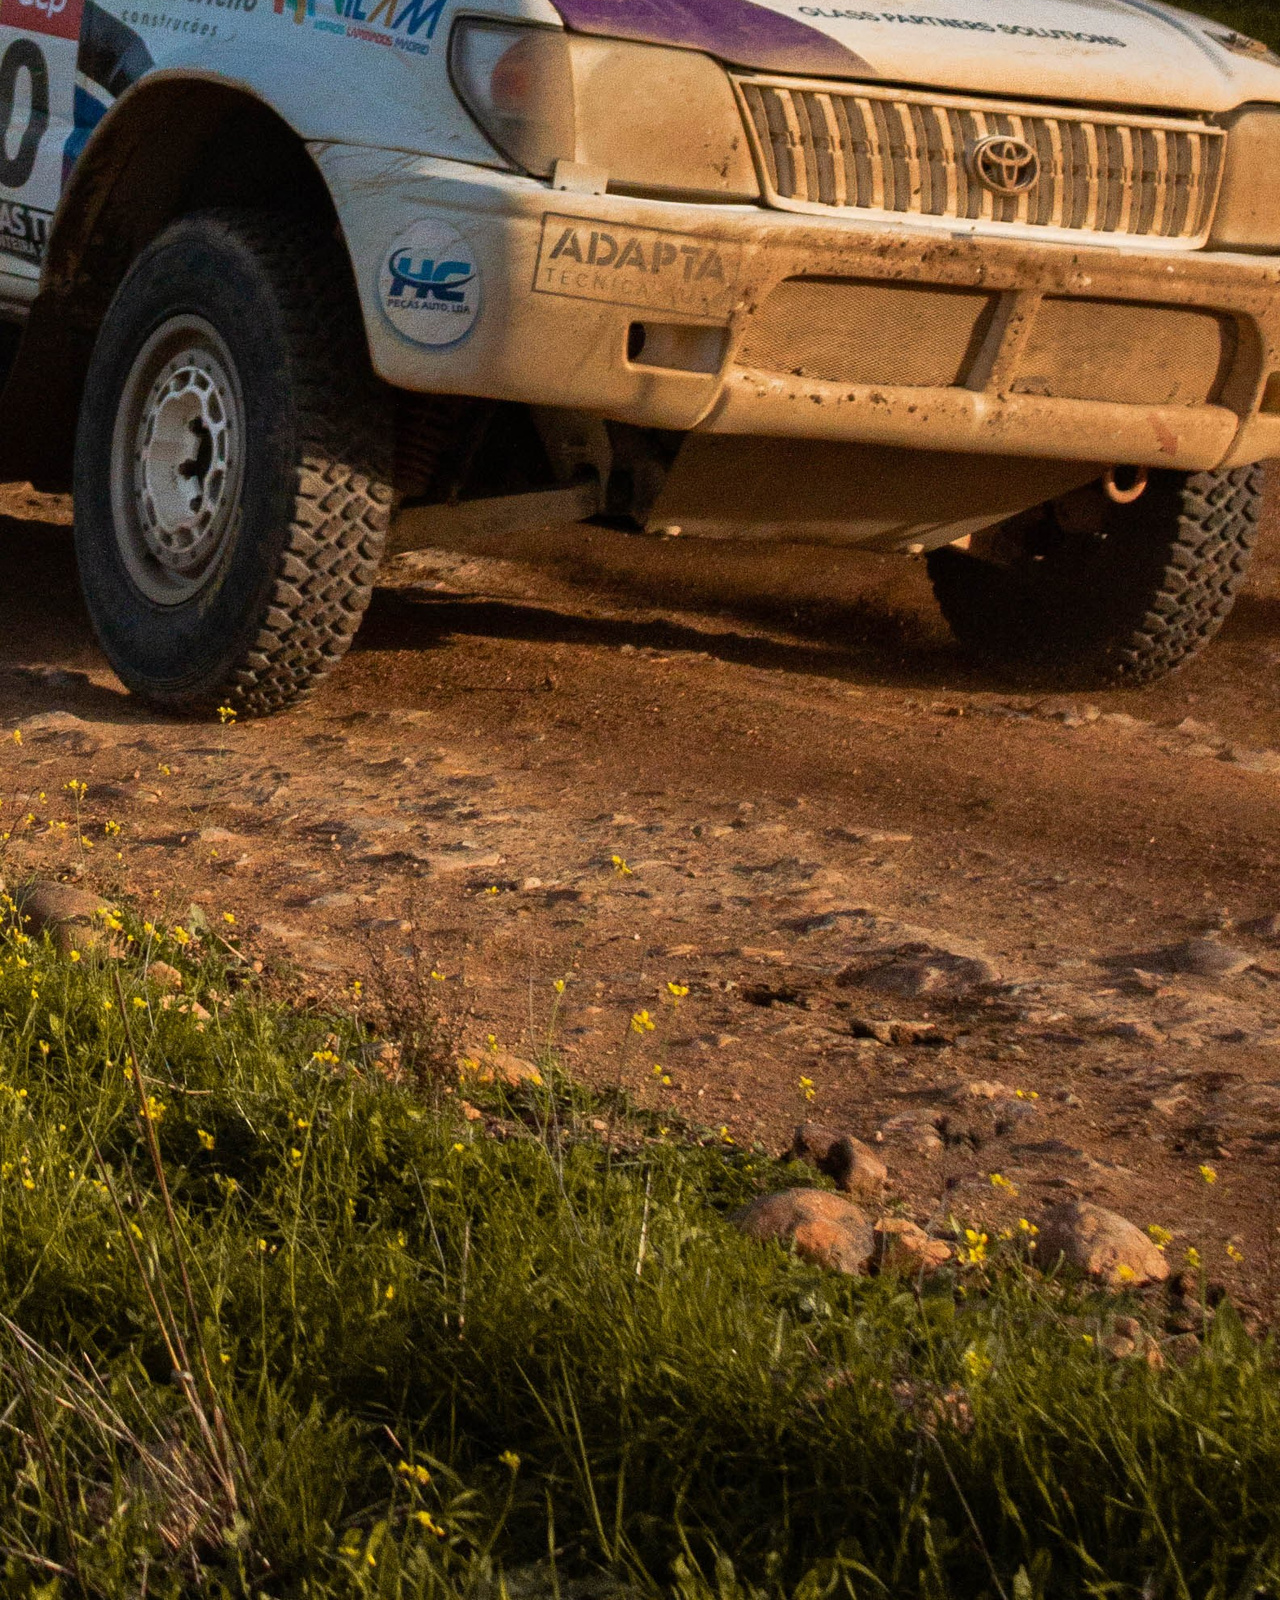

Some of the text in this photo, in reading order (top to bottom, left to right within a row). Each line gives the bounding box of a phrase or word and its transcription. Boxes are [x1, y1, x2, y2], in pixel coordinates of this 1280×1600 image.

[799, 5, 1127, 48] GLASS PARTNERS SOLUTIONS
[549, 227, 727, 284] ADAPTA
